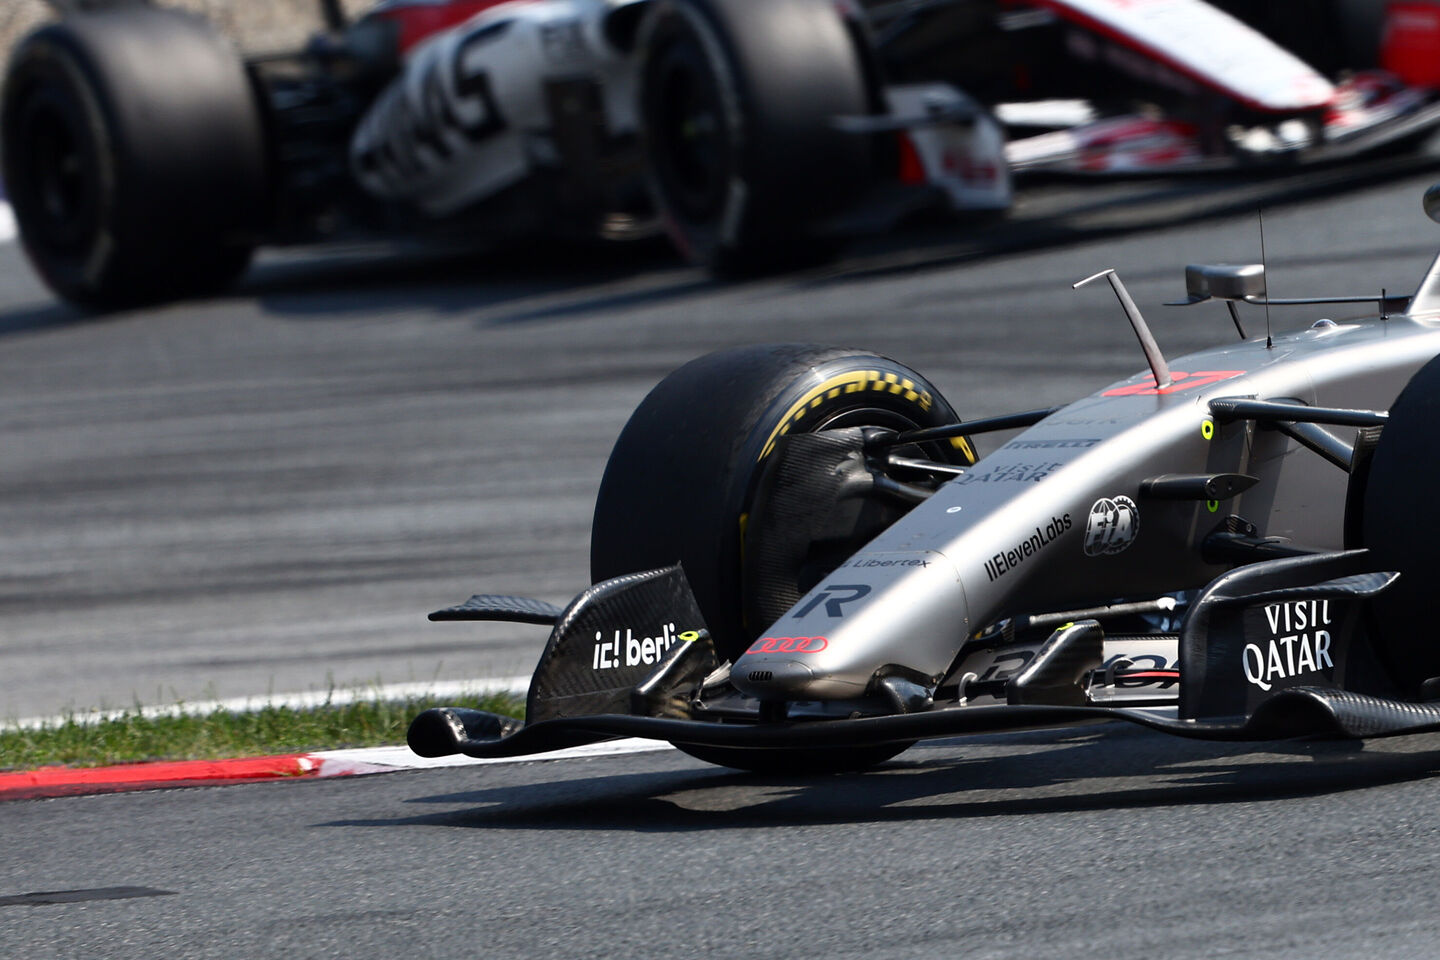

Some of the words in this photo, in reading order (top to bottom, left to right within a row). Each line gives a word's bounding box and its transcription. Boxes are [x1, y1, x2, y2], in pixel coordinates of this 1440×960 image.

[1100, 370, 1248, 397] 27
[853, 557, 931, 570] Libertex
[792, 584, 872, 618] R
[626, 622, 676, 667] berli
[1243, 629, 1334, 692] QATAR
